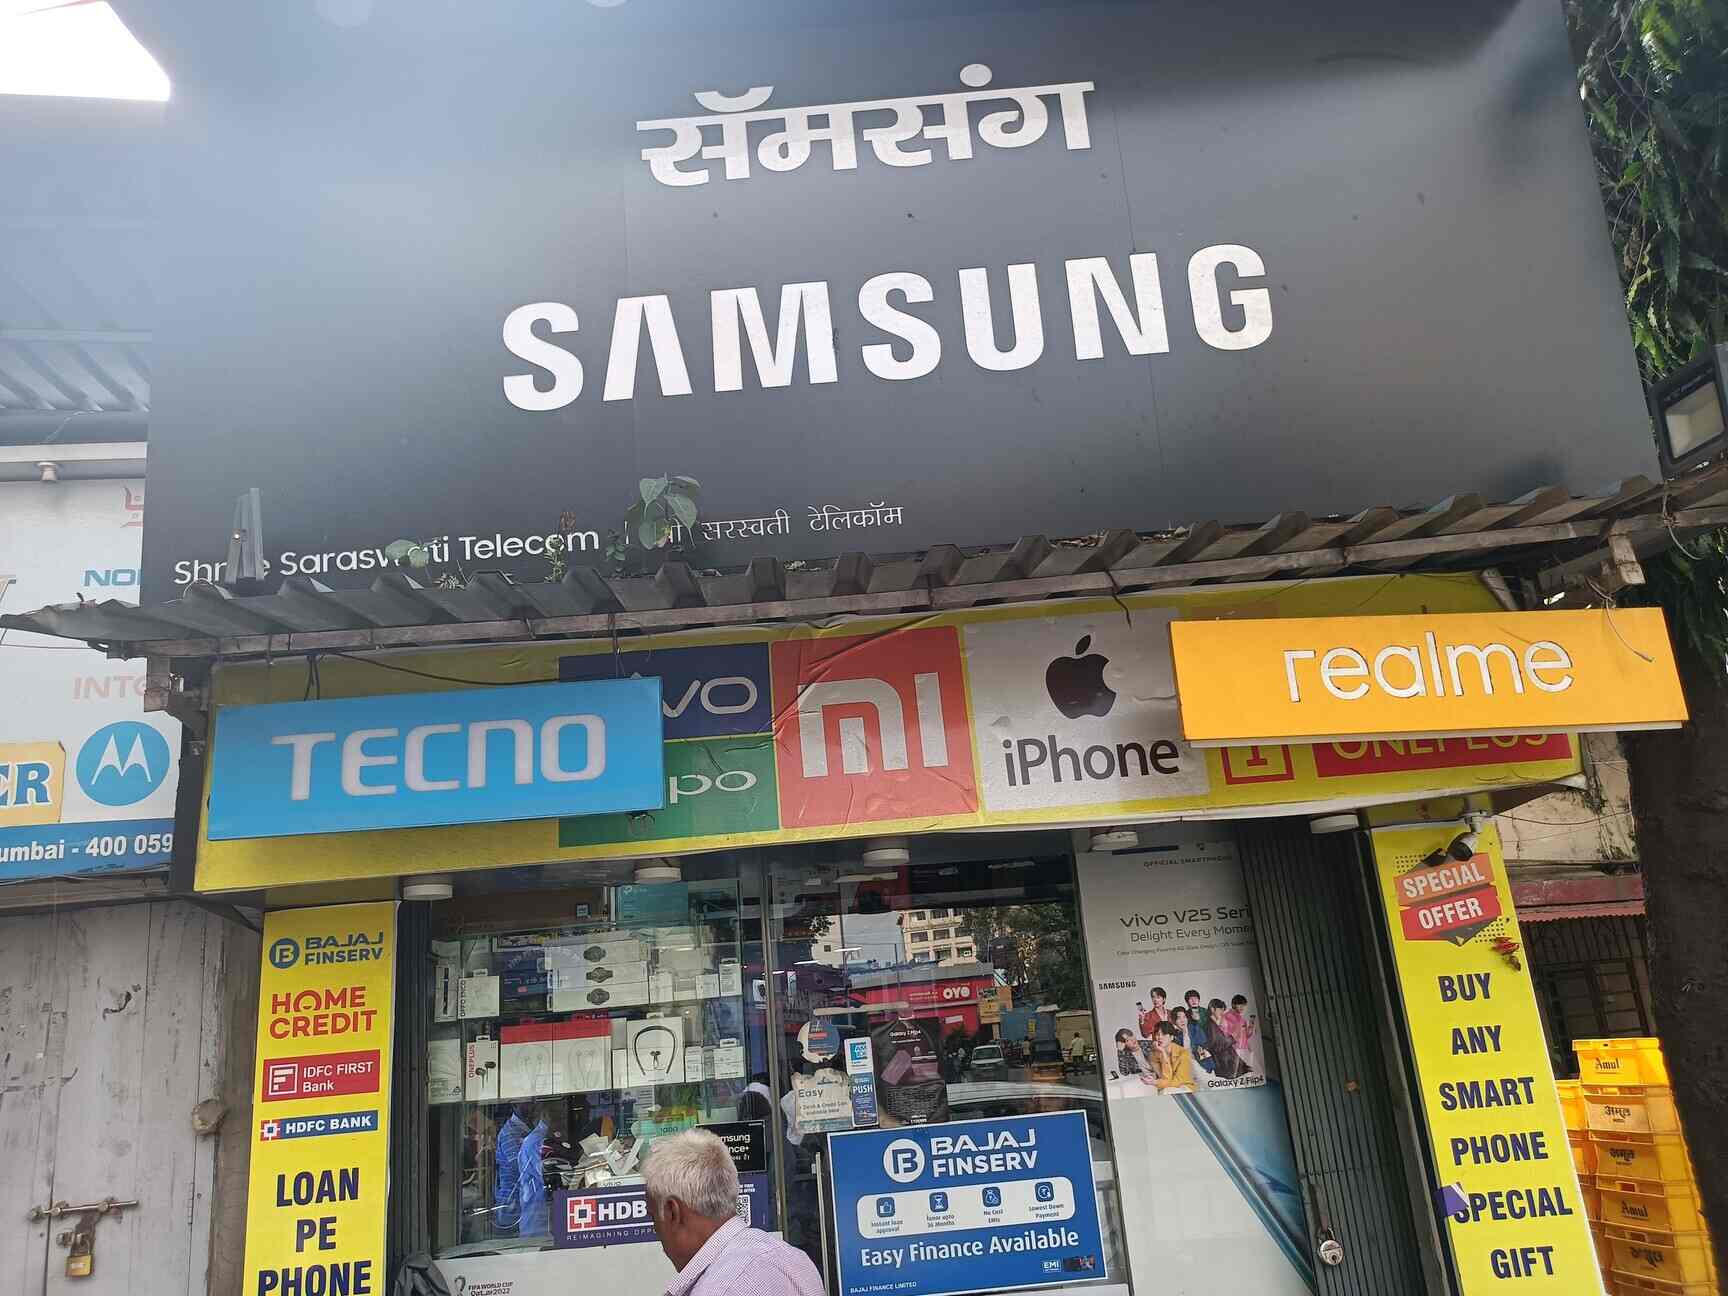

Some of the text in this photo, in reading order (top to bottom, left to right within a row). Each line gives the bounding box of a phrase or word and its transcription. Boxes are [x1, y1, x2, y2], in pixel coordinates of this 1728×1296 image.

[636, 64, 1094, 187] सॅमसंग
[502, 243, 1274, 411] SAMSUNG
[701, 506, 791, 541] सरस्वती
[807, 502, 904, 531] टेलिकॉम
[173, 558, 271, 584] Shre
[459, 530, 599, 560] Telecom
[84, 569, 142, 587] NO
[1282, 631, 1574, 703] realme
[663, 676, 758, 718] vo
[271, 713, 607, 800] TECNO
[1002, 735, 1180, 787] iPhone
[669, 770, 758, 804] po
[0, 839, 65, 863] umbai
[86, 835, 127, 857] 400
[134, 833, 174, 854] 059
[1402, 862, 1486, 898] SPECIAL
[1119, 912, 1169, 928] vivo
[1173, 908, 1213, 924] V25
[1418, 897, 1484, 929] OFFER
[304, 931, 384, 950] BAJAJ
[1130, 930, 1174, 943] Delight
[1176, 927, 1210, 939] Every
[304, 947, 384, 966] FINSERV
[271, 985, 367, 1015] HOME
[1098, 980, 1137, 990] SAMSUNG
[1438, 972, 1493, 1002] BUY
[269, 1009, 378, 1039] CREDIT
[1450, 1025, 1503, 1056] ANY
[303, 1061, 375, 1079] IDFC FIRST
[1594, 1056, 1621, 1070] Amul
[303, 1079, 335, 1092] Bank
[798, 1088, 824, 1099] Easy
[852, 1084, 874, 1094] PUSH
[1207, 1078, 1238, 1089] Galaxy
[1439, 1076, 1535, 1111] SMART
[285, 1115, 373, 1134] HDFC BANK
[720, 1134, 751, 1144] msung
[930, 1128, 1036, 1156] BAJAJ
[1450, 1131, 1549, 1166] PHONE
[932, 1150, 1039, 1178] FINSERV
[276, 1167, 360, 1207] LOAN
[598, 1200, 648, 1222] HDB
[1621, 1201, 1650, 1219] Amul
[295, 1216, 338, 1253] PE
[566, 1229, 629, 1242] REIMAGINING
[860, 1227, 1080, 1269] Easy Finance Available
[1490, 1246, 1554, 1279] GIFT
[257, 1260, 373, 1296] PHONE
